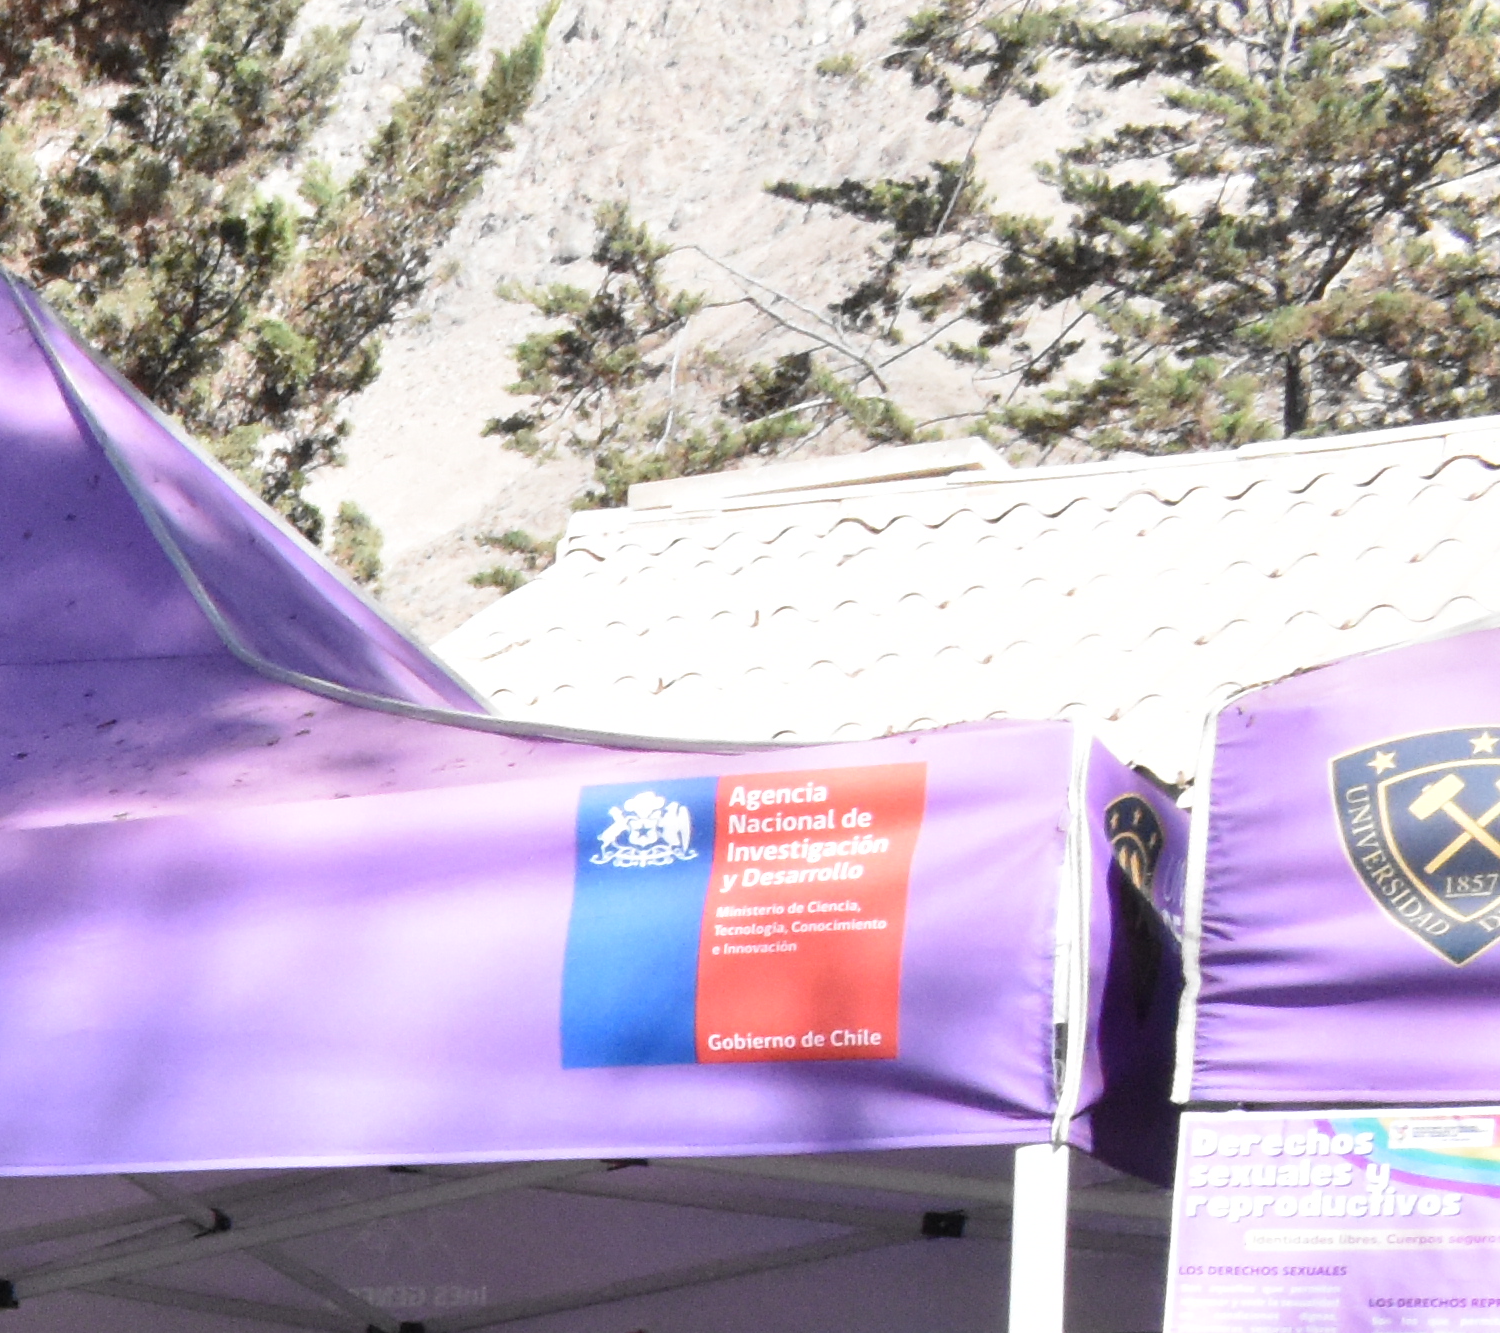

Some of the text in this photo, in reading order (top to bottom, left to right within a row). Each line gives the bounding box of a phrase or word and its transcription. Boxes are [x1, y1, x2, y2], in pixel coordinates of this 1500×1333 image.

[729, 782, 828, 811] Agencia
[728, 807, 872, 834] Nacional de
[727, 835, 889, 863] Investigación
[720, 861, 864, 893] y Desarrollo
[1446, 873, 1499, 894] 1857
[715, 900, 862, 918] Ministerio de Ciencia,
[714, 919, 888, 937] Tecnología, Conocimiento
[712, 941, 798, 955] e Innovación
[708, 1029, 882, 1051] Gobierno de Chile
[1191, 1127, 1375, 1158] Derechos
[1188, 1160, 1391, 1193] sexuales y
[1185, 1186, 1463, 1223] reproductivos
[1386, 1232, 1444, 1247] Cuerpos
[1448, 1234, 1500, 1247] seguro
[1178, 1265, 1349, 1277] LOS DERECHOS SEXUALES
[1368, 1298, 1394, 1309] LOS
[1397, 1298, 1468, 1309] DERECHOS
